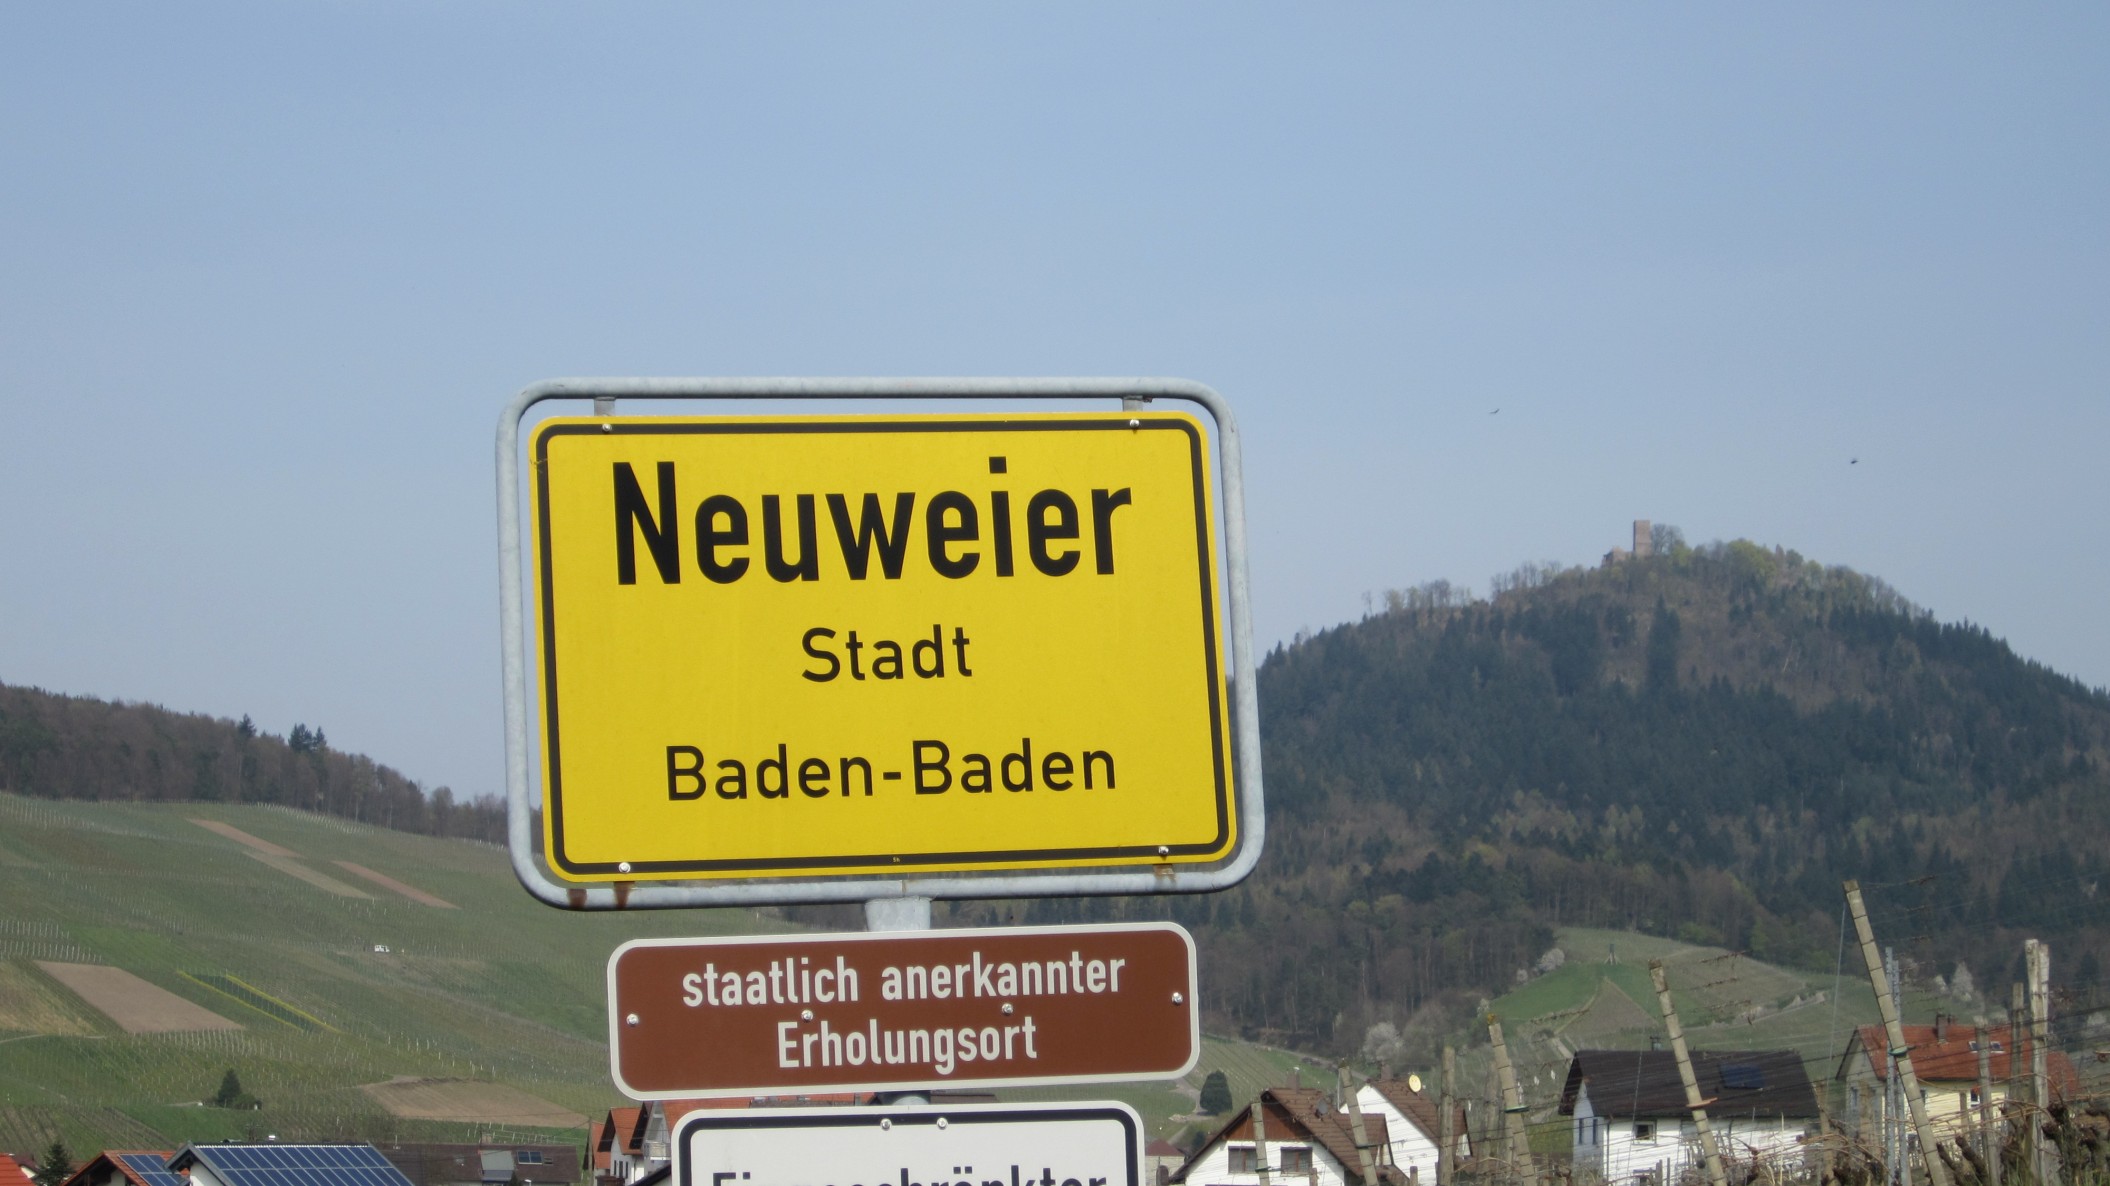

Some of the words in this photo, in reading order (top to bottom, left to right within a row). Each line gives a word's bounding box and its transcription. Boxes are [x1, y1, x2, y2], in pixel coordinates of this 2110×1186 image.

[613, 457, 1131, 585] Neuweier
[802, 624, 972, 682] Stadt
[667, 738, 1115, 800] Baden-Baden
[683, 956, 858, 1007] staatlich
[882, 951, 1125, 1000] anerkannter
[778, 1017, 1037, 1075] Erholungsort
